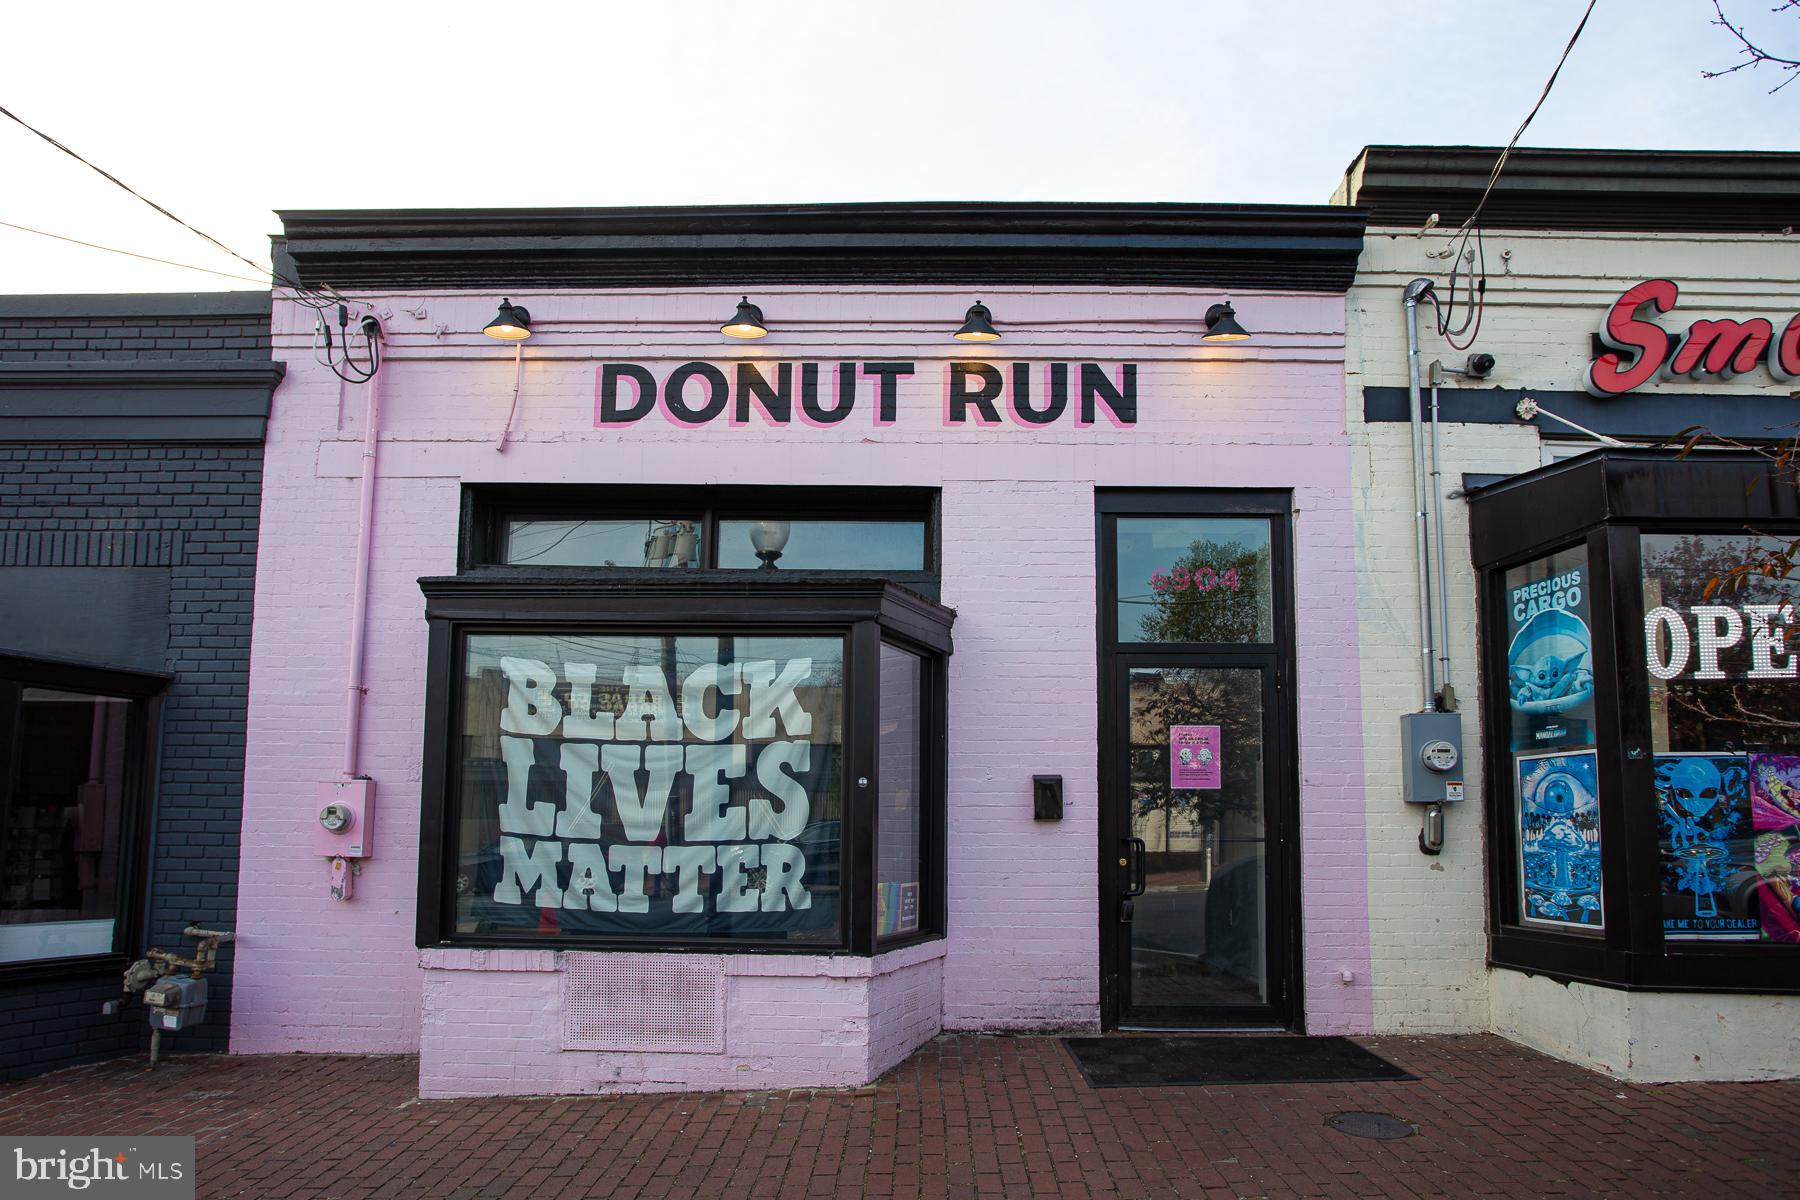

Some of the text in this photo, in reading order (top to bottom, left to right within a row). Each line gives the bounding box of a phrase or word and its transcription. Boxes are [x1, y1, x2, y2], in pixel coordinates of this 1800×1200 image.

[595, 361, 1138, 427] DONUT RUN
[1151, 565, 1240, 592] 6904
[1512, 570, 1581, 603] PRECIOUS
[1513, 586, 1582, 622] CARGO
[1644, 604, 1799, 680] OPE
[500, 656, 812, 741] BLACK
[498, 735, 811, 841] LIVES
[493, 835, 812, 914] MATTER
[1677, 919, 1689, 928] ME
[1693, 919, 1704, 929] TO
[1705, 919, 1725, 928] YOUR
[1727, 918, 1758, 928] DEALER
